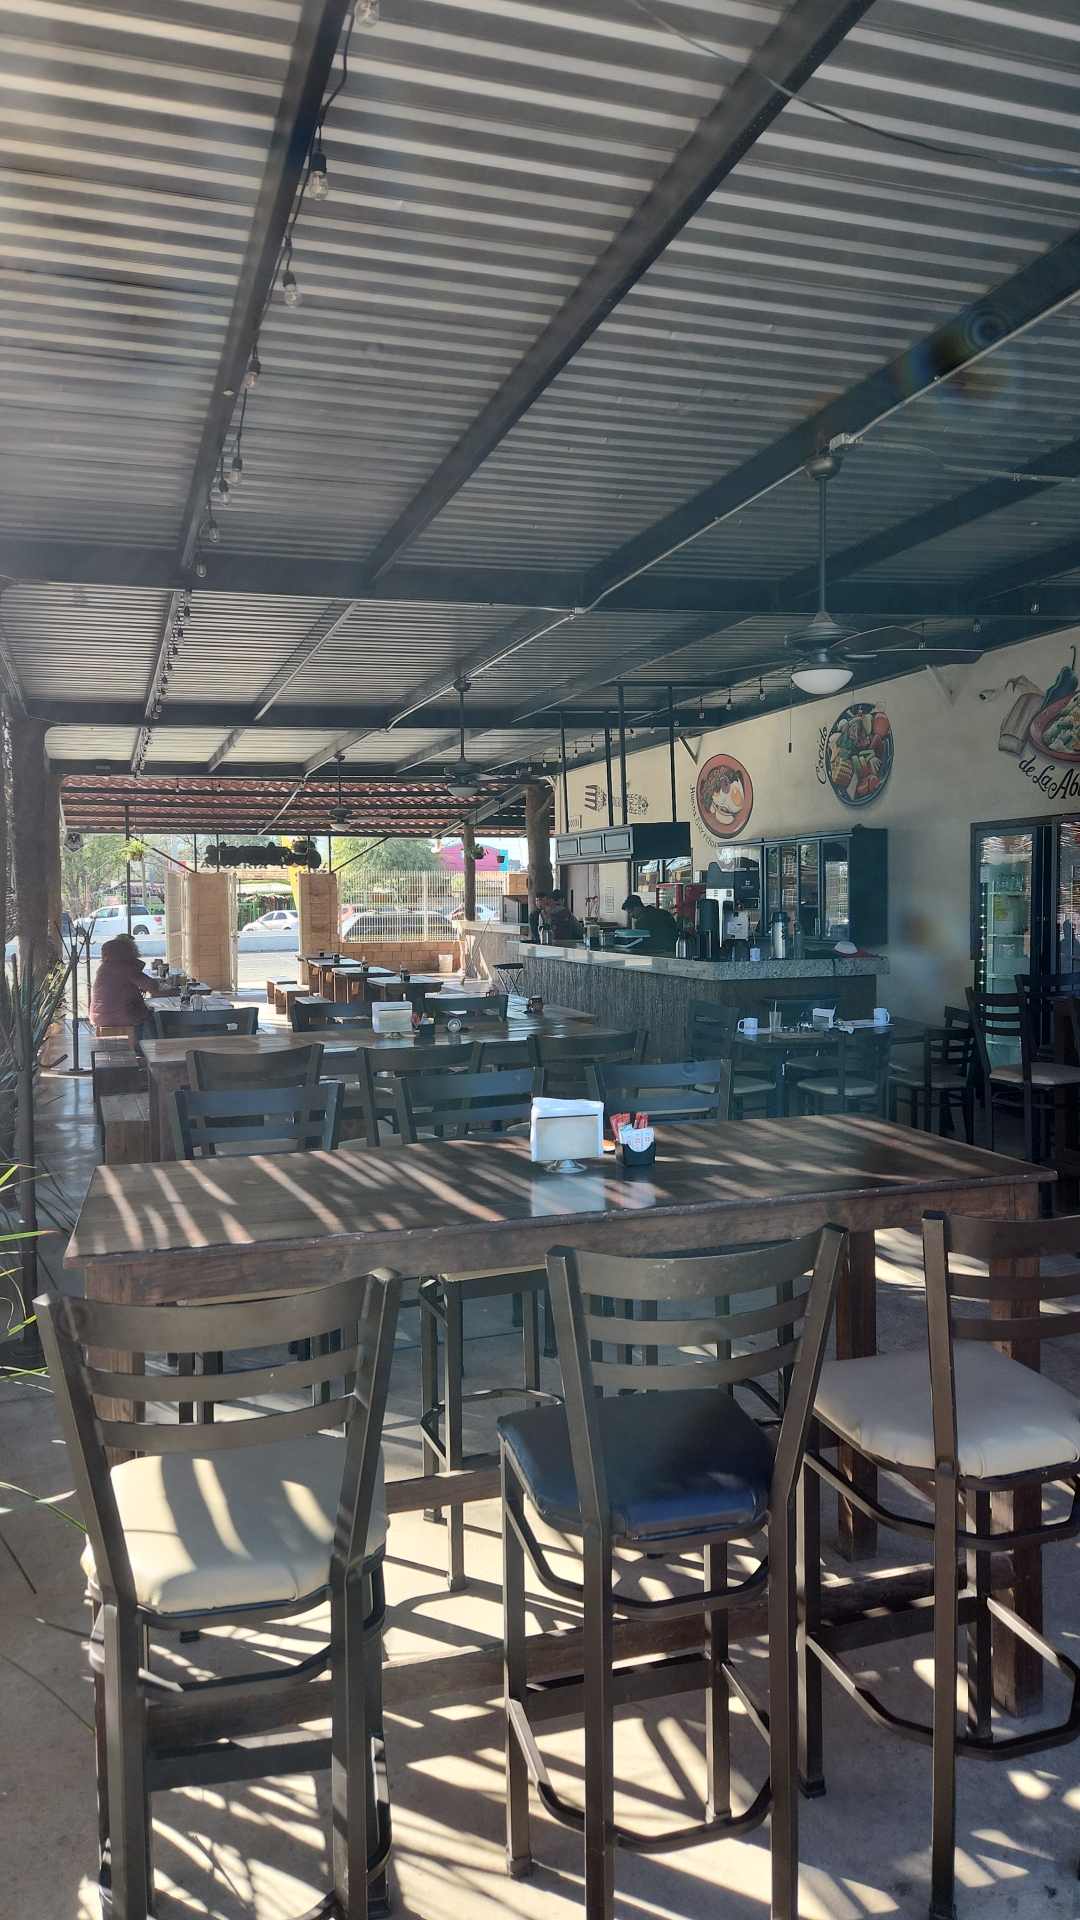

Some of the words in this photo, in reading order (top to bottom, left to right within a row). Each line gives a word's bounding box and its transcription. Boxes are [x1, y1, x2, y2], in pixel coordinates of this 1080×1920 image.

[815, 726, 828, 784] Cocido
[1018, 754, 1037, 778] de
[1032, 765, 1056, 792] La
[1047, 768, 1080, 800] Ab
